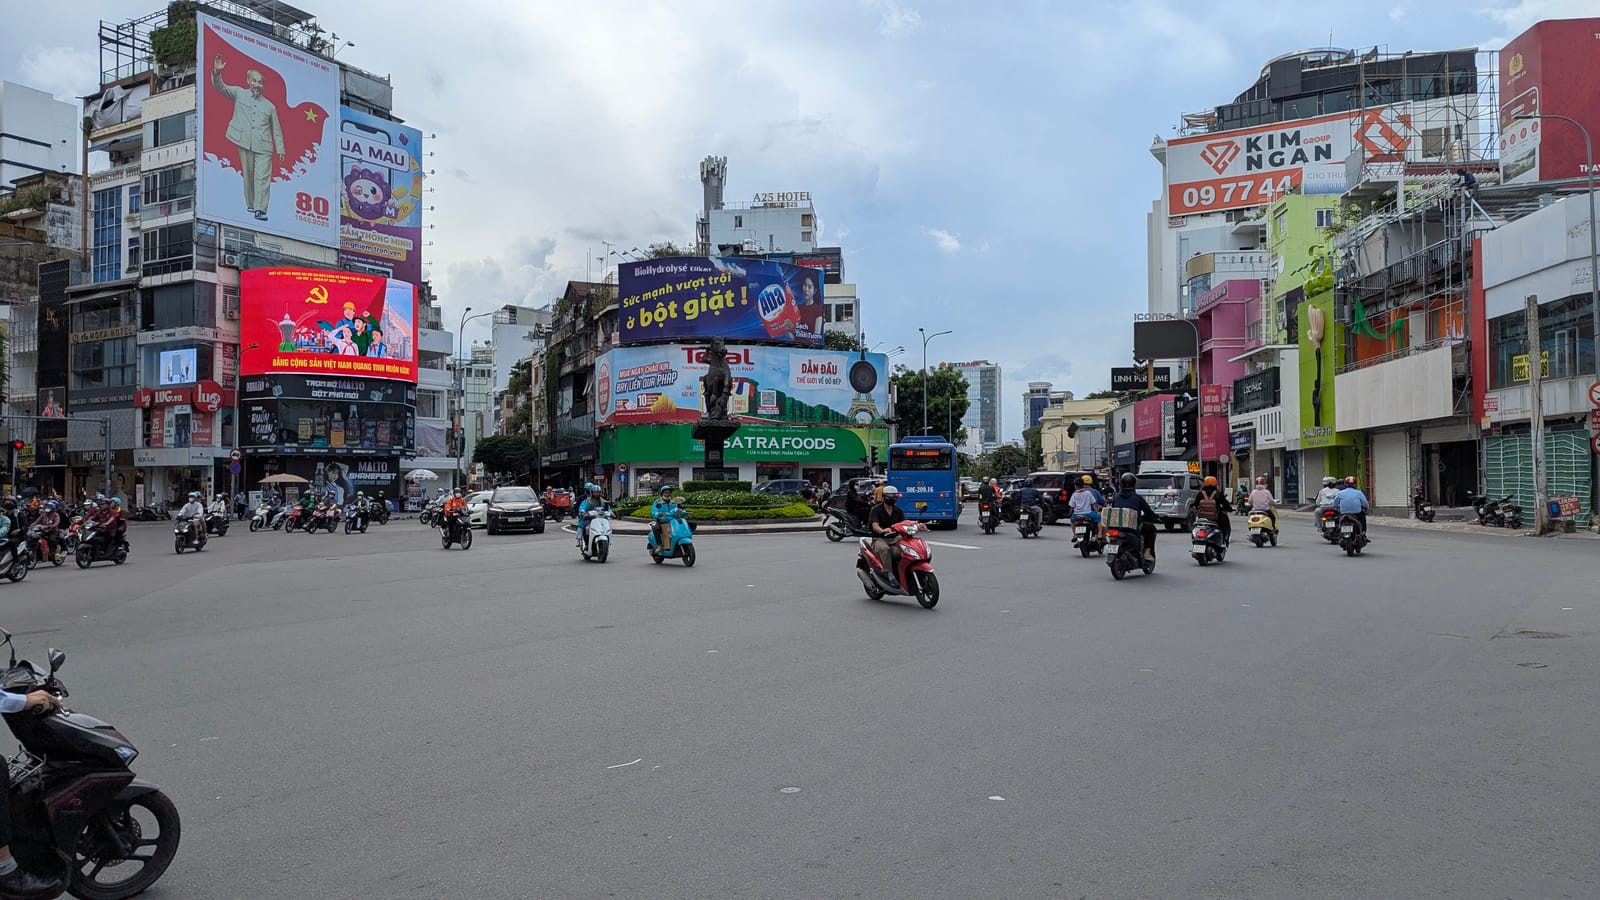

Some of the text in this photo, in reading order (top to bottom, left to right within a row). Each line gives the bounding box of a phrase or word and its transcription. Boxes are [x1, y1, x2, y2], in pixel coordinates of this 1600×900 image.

[1246, 130, 1300, 154] KIM
[1303, 134, 1331, 144] GROUP
[369, 146, 404, 166] MAU
[1246, 144, 1332, 171] NGAN
[1326, 170, 1345, 179] THU
[296, 192, 329, 216] 80
[753, 192, 812, 202] A25 HOTEL
[634, 264, 688, 277] BioHydrolysé
[623, 272, 732, 308] Sức mạnh vượt trội
[626, 286, 748, 330] ở bột giặt !
[759, 287, 785, 316] Aba
[272, 357, 288, 367] ĐẢNG
[290, 358, 308, 369] CỘNG
[309, 357, 322, 367] SẢN
[323, 359, 336, 370] VIỆT
[352, 362, 371, 371] QUANG
[616, 381, 629, 392] BAY
[657, 370, 677, 386] PHÁP
[1134, 374, 1168, 382] PERUME
[198, 384, 220, 411] lug
[639, 395, 647, 406] 10
[359, 462, 388, 472] MALTO
